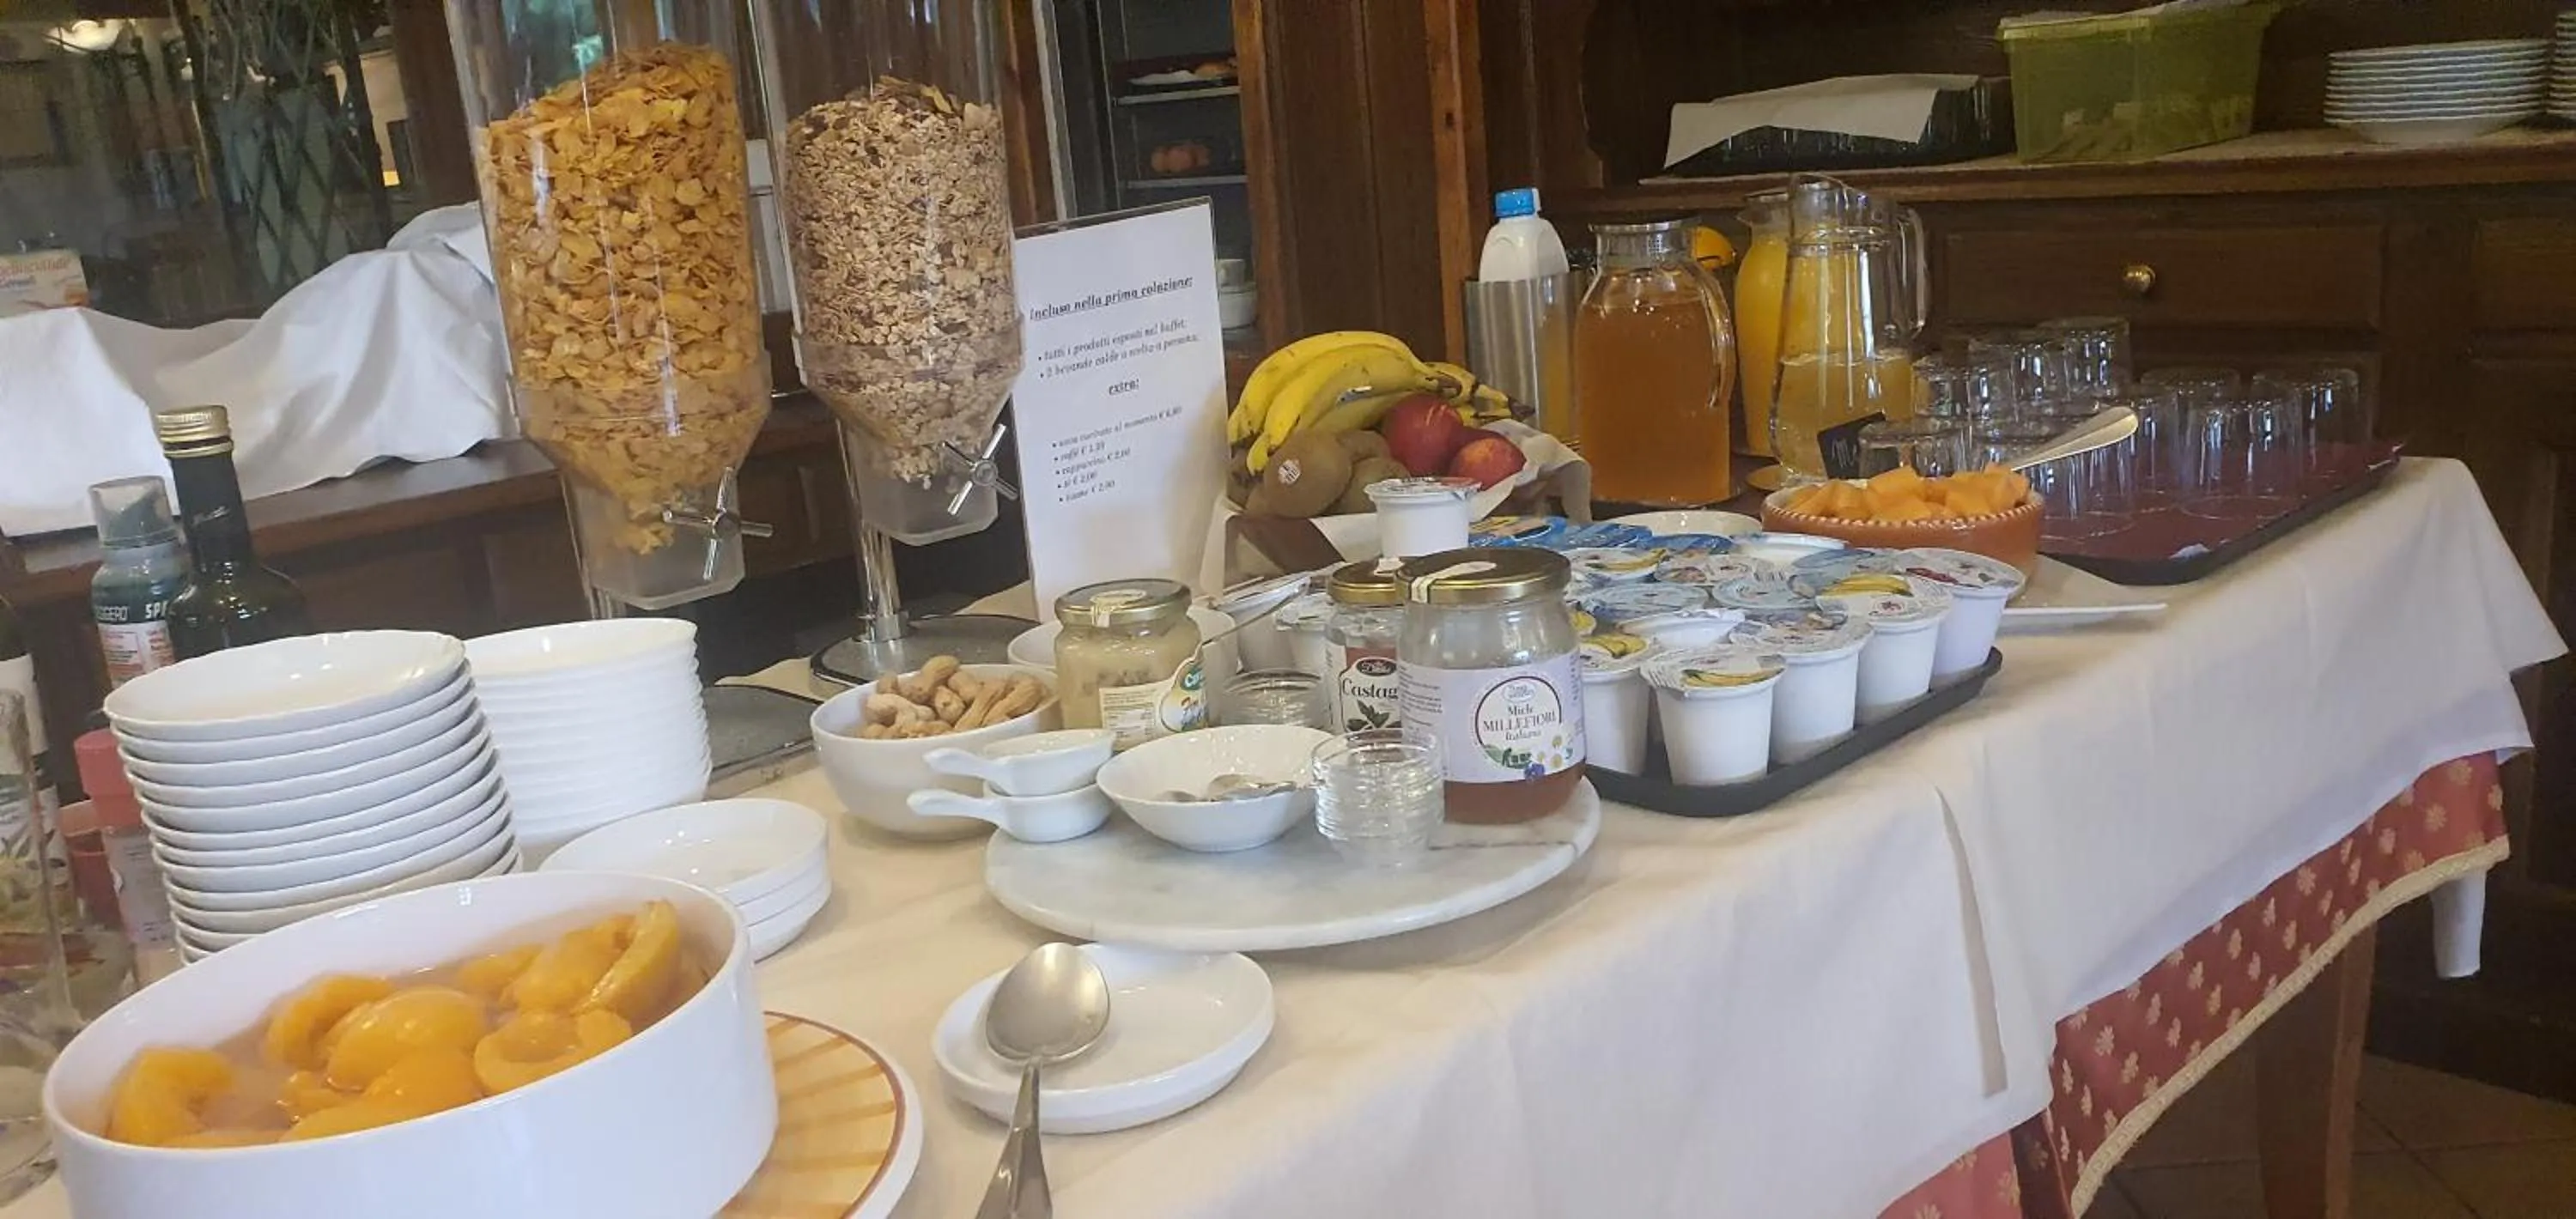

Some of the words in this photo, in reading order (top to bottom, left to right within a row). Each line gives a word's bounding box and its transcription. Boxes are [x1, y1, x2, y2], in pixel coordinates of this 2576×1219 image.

[1030, 302, 1071, 321] Incluso
[1074, 294, 1103, 311] nella
[1105, 288, 1139, 307] prima
[1072, 336, 1110, 355] prodotti
[1054, 357, 1093, 376] bevande
[1095, 350, 1119, 367] calde
[1508, 703, 1534, 716] Miele
[1483, 710, 1557, 732] MILLEFIORI
